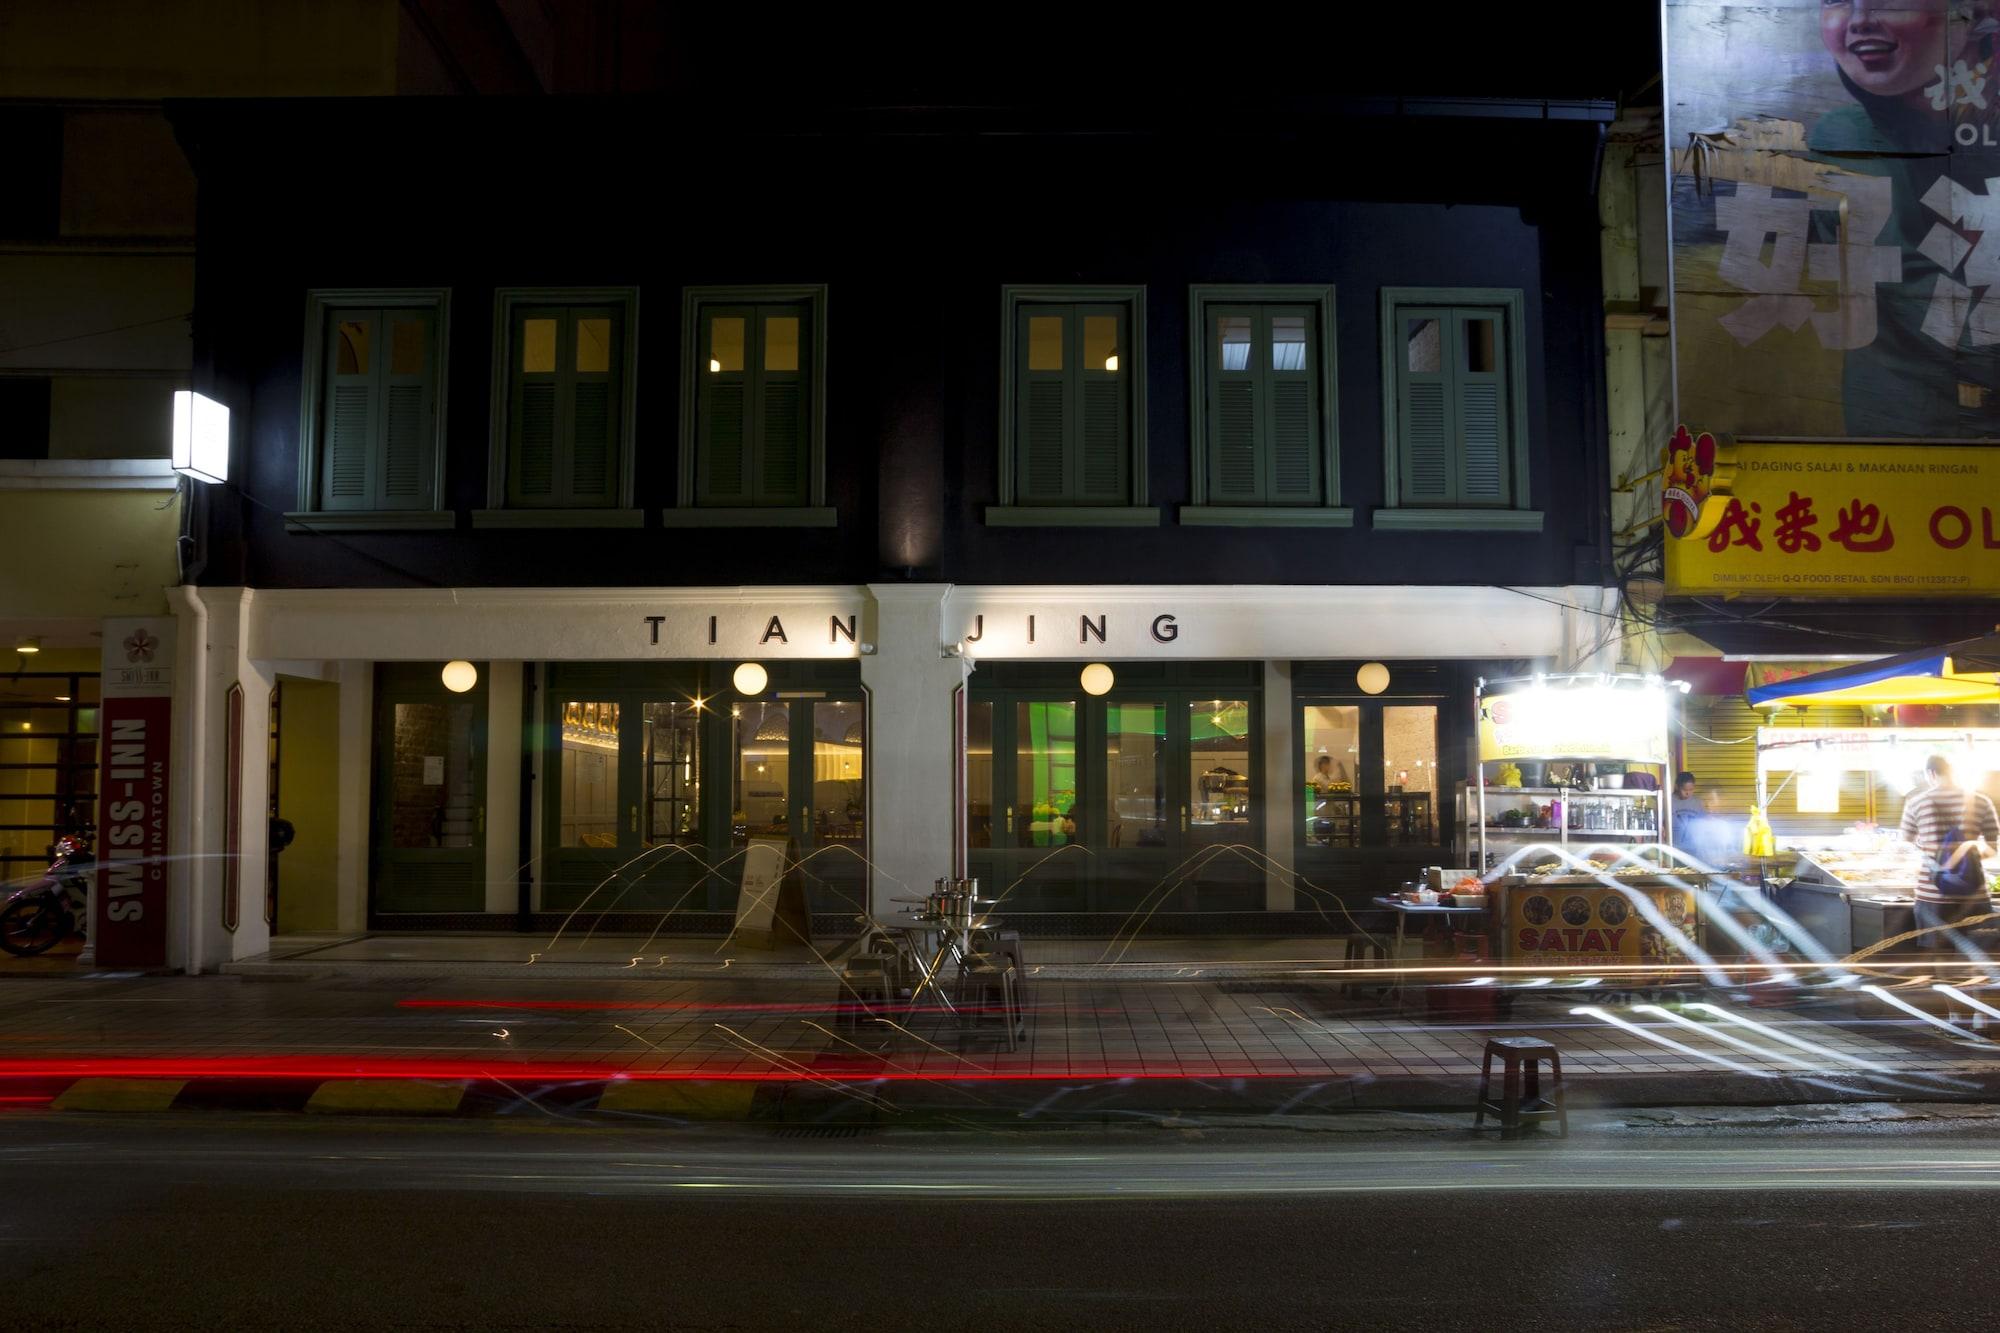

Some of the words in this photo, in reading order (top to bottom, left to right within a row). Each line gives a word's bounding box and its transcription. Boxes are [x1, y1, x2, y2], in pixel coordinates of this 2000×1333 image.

[1752, 461, 1802, 472] DAGING
[1807, 462, 1842, 473] SALAI
[1846, 463, 1856, 473] &
[1859, 463, 1926, 474] MAKANAN
[1929, 464, 1978, 475] RINGAN
[1754, 573, 1781, 583] OLEH
[1803, 574, 1832, 583] FOOD
[1834, 575, 1868, 584] RETAIL
[644, 615, 856, 645] TIAN
[965, 614, 1179, 644] JING
[107, 719, 146, 922] SWISS-INN
[151, 761, 163, 880] CHINATOWN
[1519, 927, 1627, 952] SATAY
